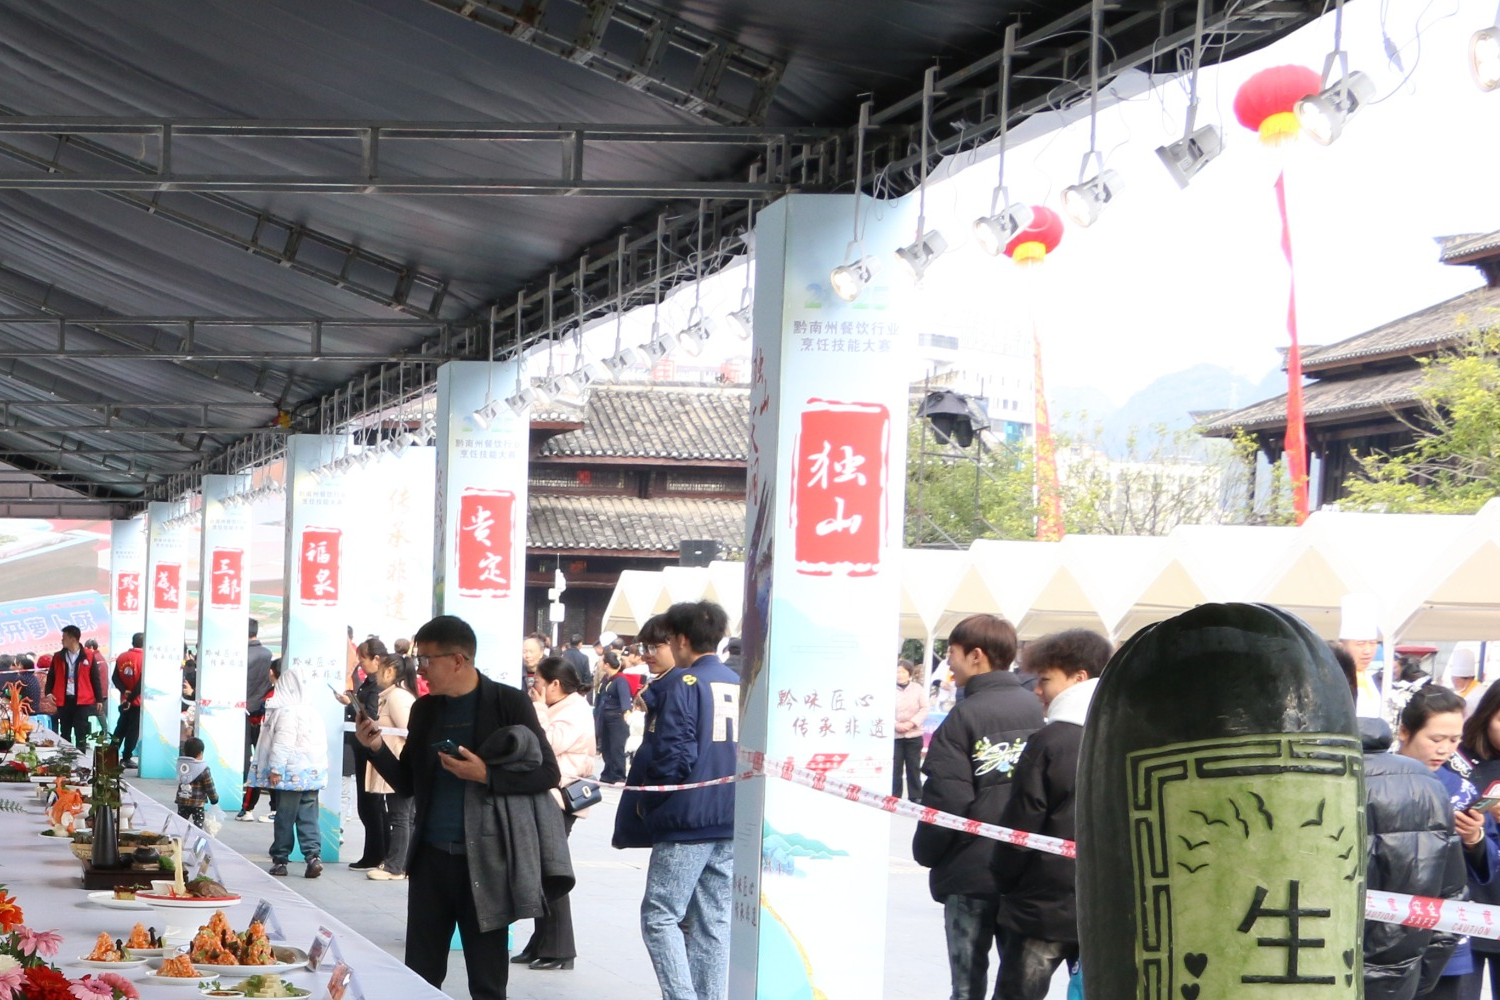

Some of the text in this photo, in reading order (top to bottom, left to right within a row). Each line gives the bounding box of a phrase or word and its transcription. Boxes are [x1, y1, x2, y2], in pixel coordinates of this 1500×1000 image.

[793, 320, 900, 336] 黔南州餐饮行业
[800, 337, 892, 353] 烹饪技能大赛
[806, 440, 868, 536] 独山
[462, 505, 508, 584] 贵定
[213, 558, 242, 600] 三都
[305, 540, 336, 596] 福泉
[119, 574, 139, 609] 黔南
[156, 570, 178, 603] 荔波
[777, 689, 875, 711] 黔味匠心
[792, 717, 888, 739] 传承非遗
[1408, 915, 1436, 927] SAFE
[1452, 922, 1491, 936] CAUTION
